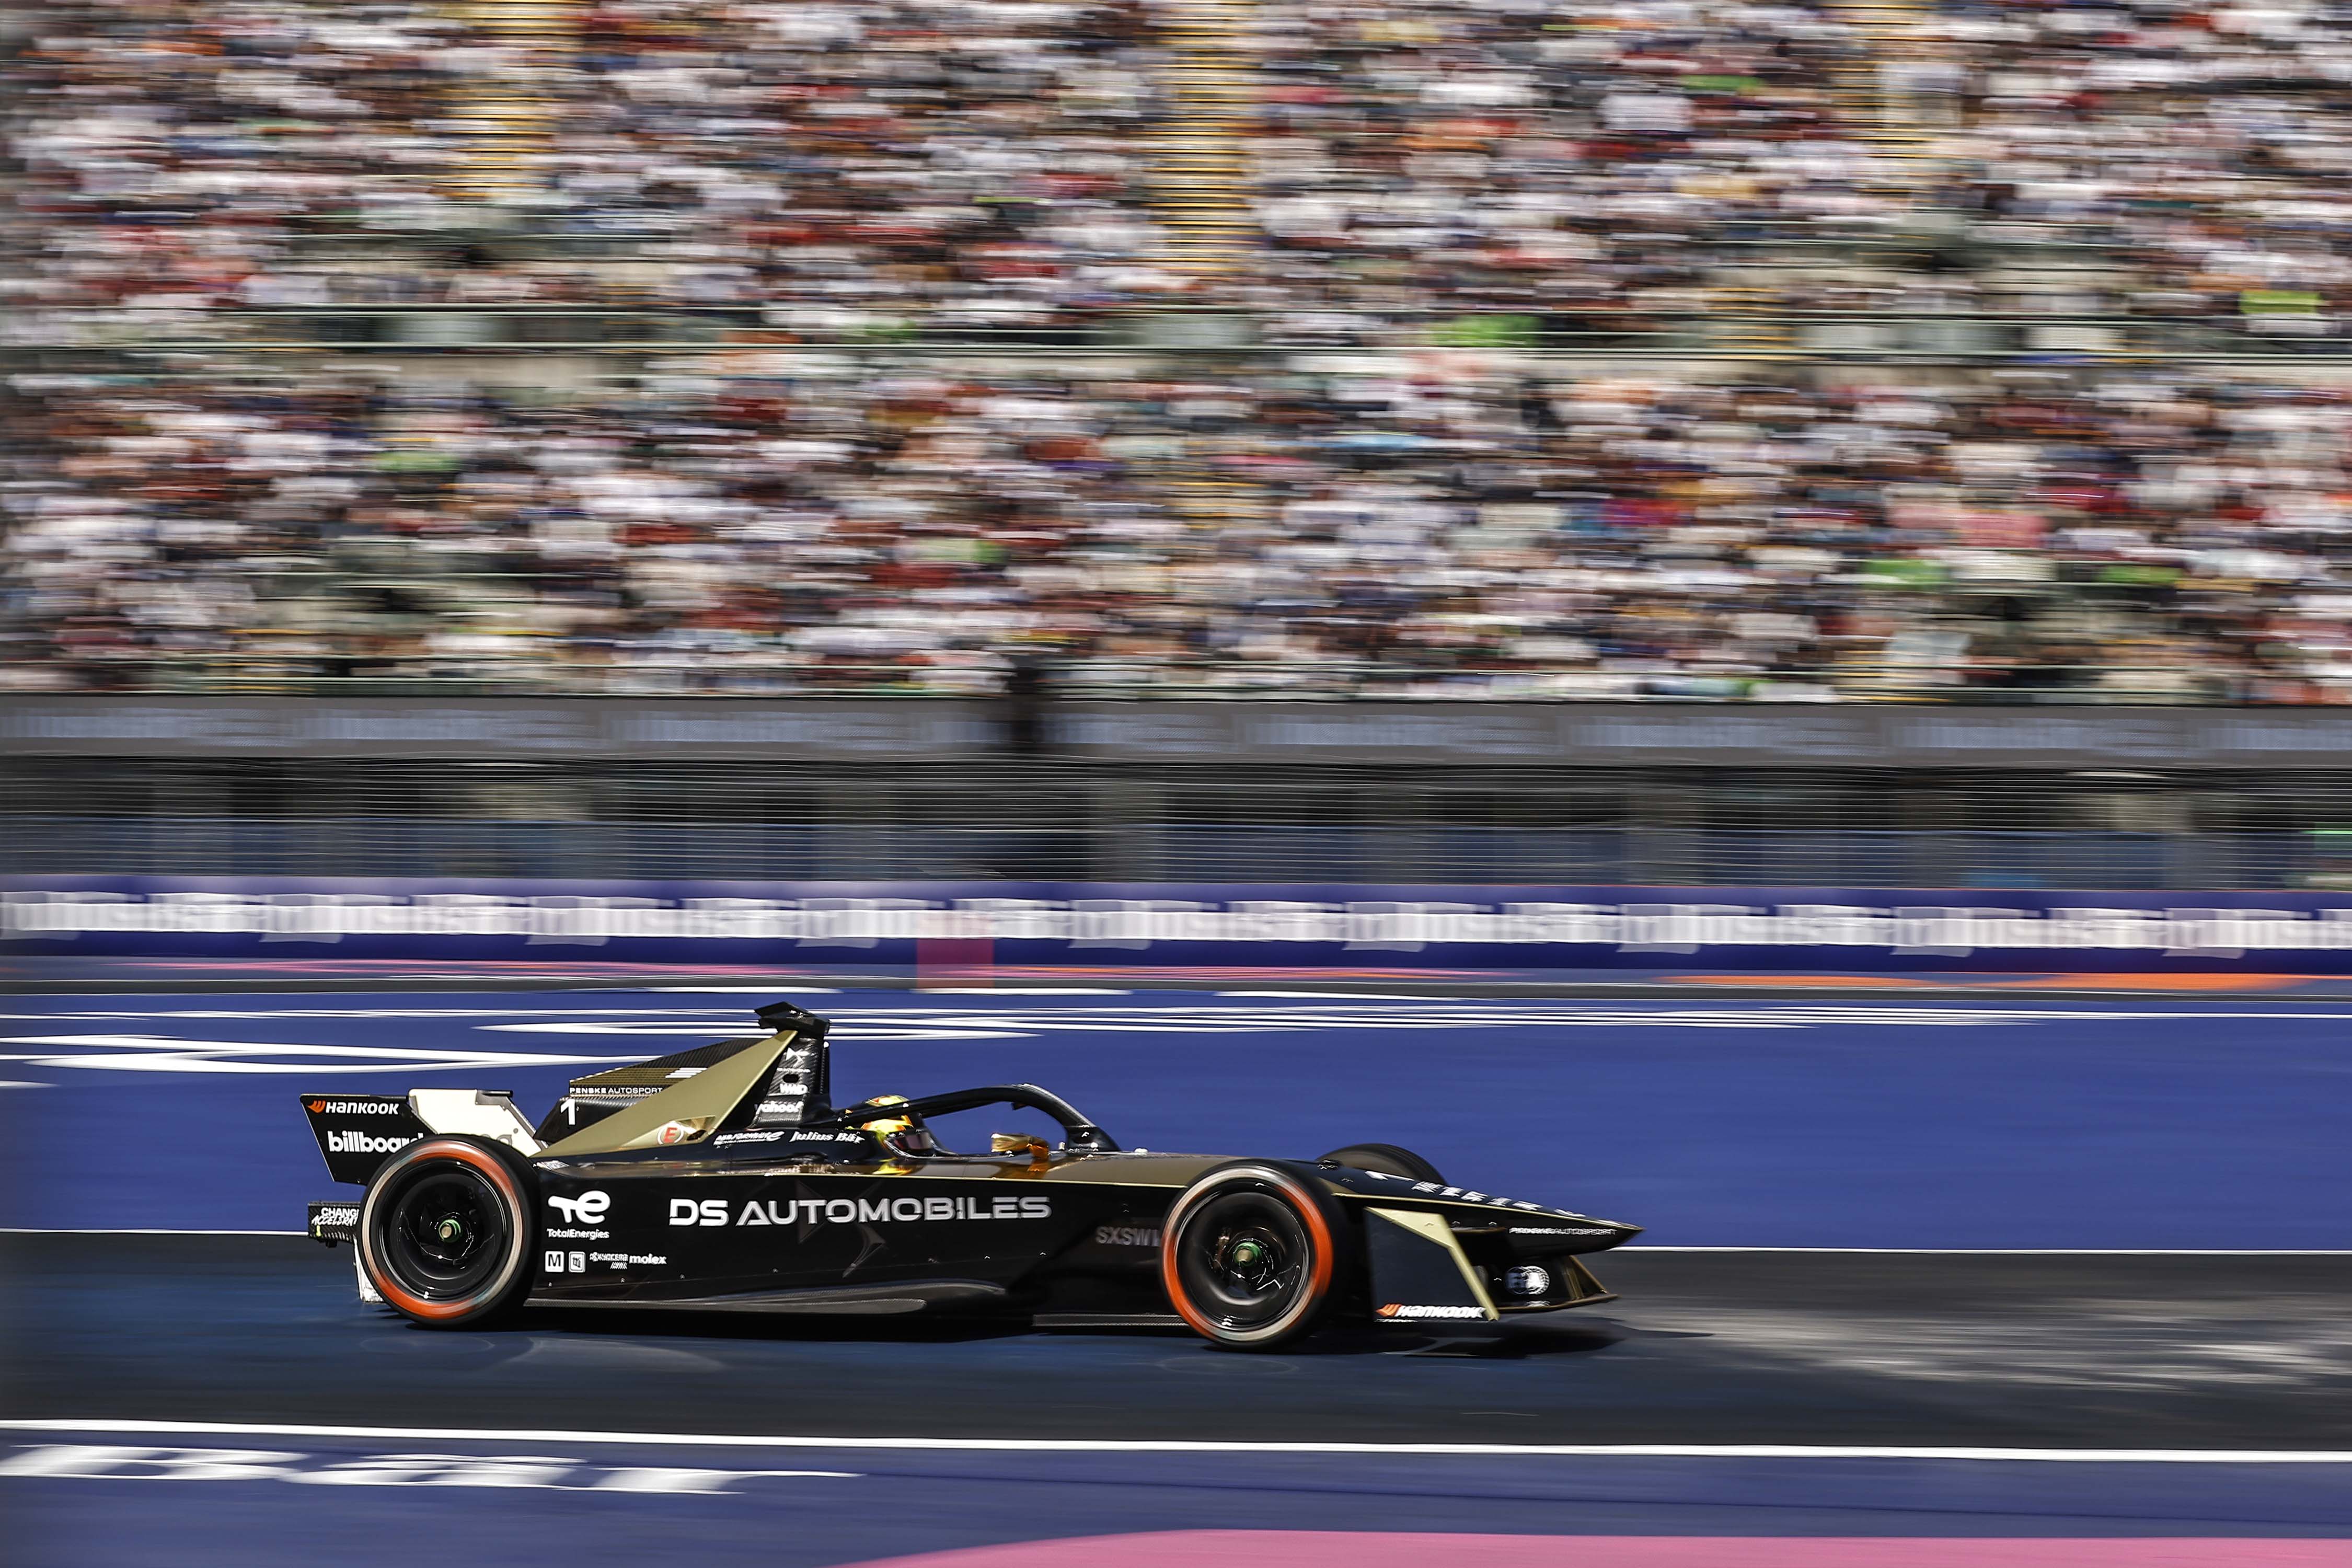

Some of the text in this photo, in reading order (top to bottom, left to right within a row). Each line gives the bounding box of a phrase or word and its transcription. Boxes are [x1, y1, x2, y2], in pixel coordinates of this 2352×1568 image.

[560, 1098, 575, 1125] 1
[327, 1130, 424, 1153] billboar
[789, 1131, 834, 1143] Julius
[669, 1196, 1052, 1227] DS AUTOMOBILES
[547, 1228, 610, 1240] TotalEnergies
[629, 1253, 667, 1264] molex
